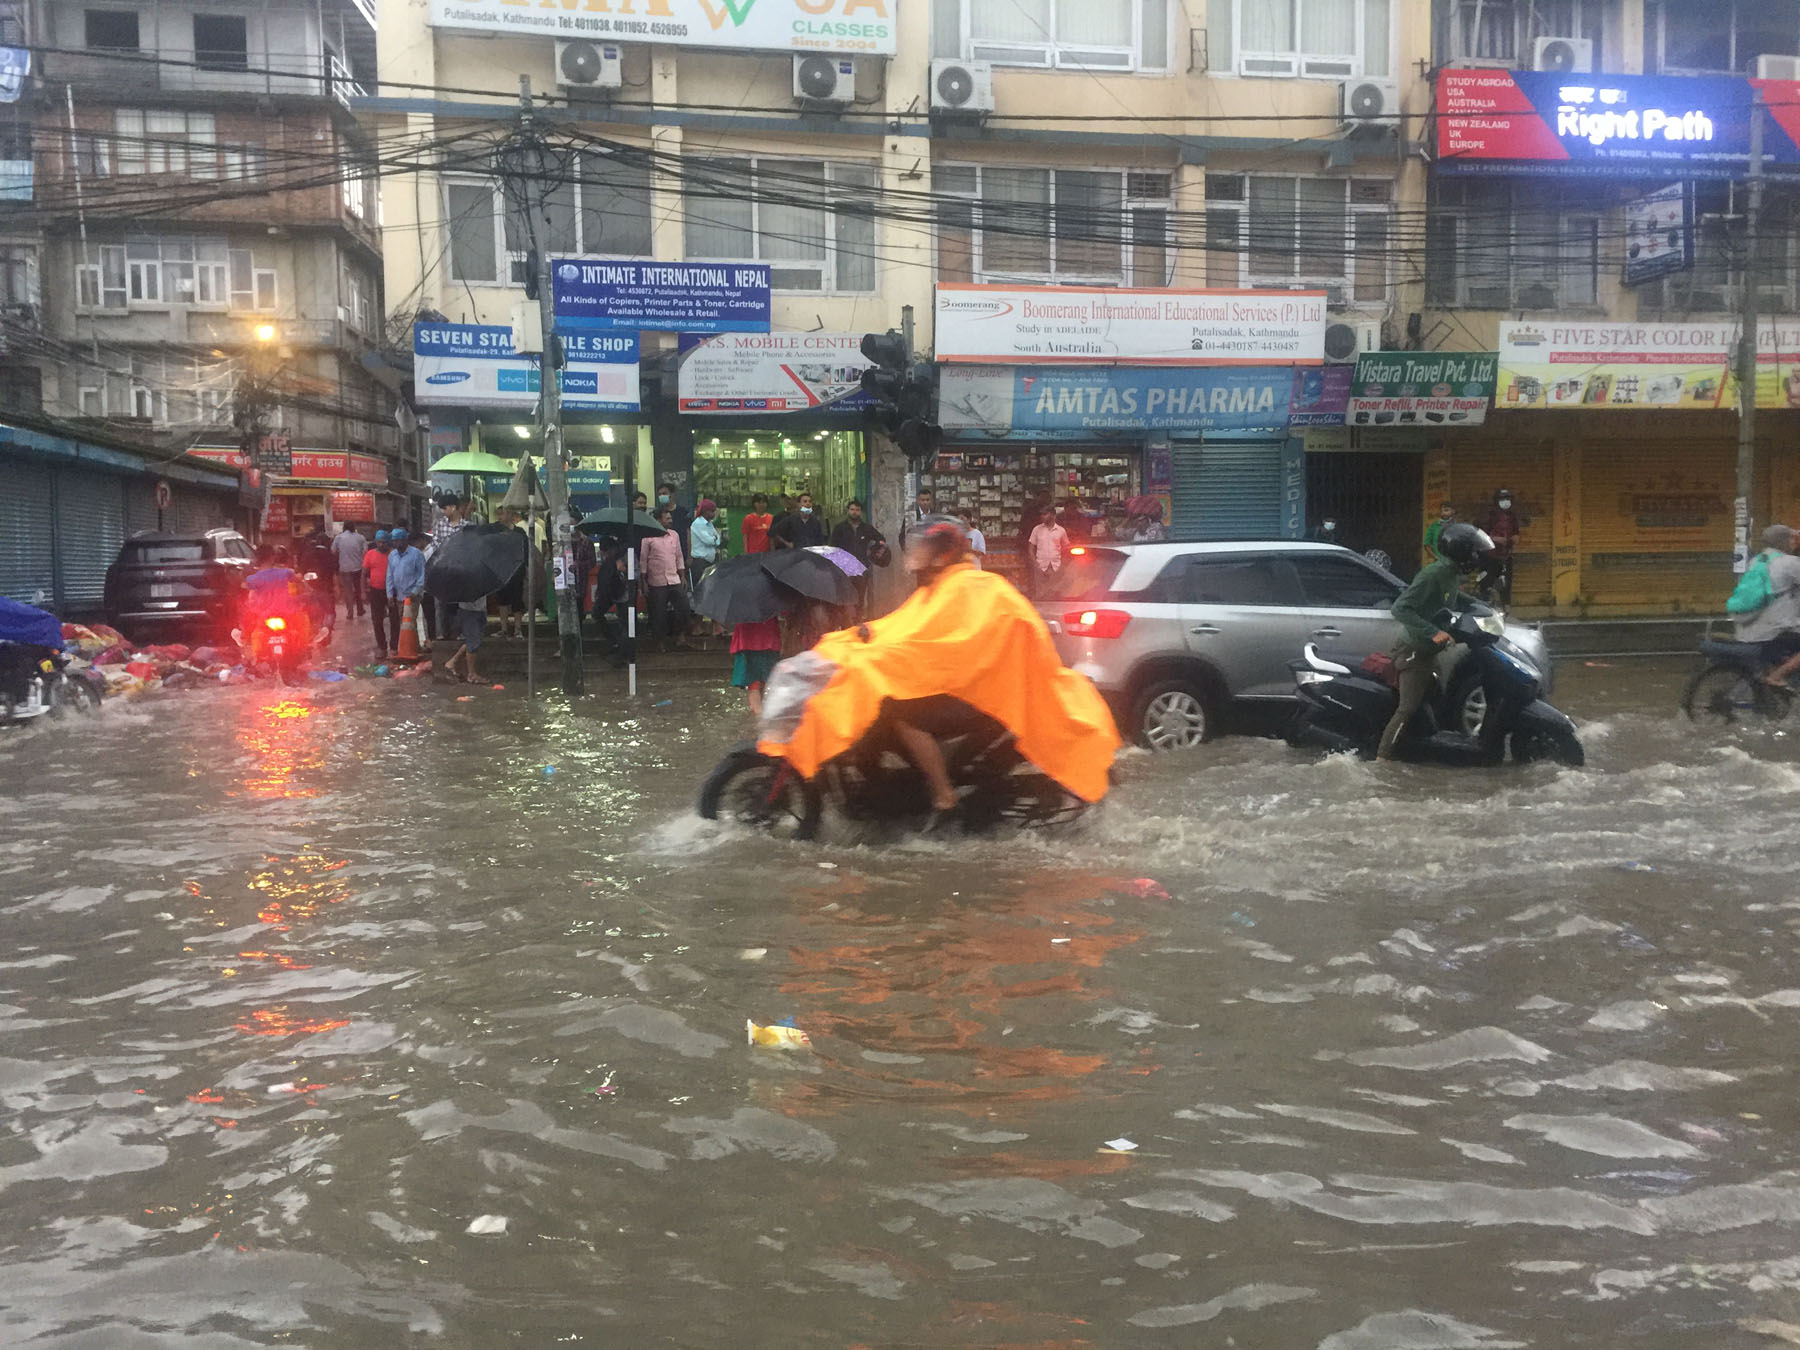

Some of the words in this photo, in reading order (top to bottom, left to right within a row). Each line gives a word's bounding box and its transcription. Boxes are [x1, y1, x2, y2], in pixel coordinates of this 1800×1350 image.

[503, 12, 556, 27] Kathmandu
[558, 16, 573, 29] Tel:
[792, 20, 888, 38] CLASSES
[792, 36, 830, 48] Since
[836, 38, 877, 49] 2004
[1446, 77, 1475, 87] STUDY
[1477, 79, 1515, 87] ABROAD
[1446, 88, 1465, 96] USA
[1448, 98, 1496, 107] AUSTRALIA
[1448, 119, 1468, 128] NEW
[1470, 120, 1510, 129] ZEALAND
[1557, 105, 1639, 145] Right
[1643, 108, 1713, 141] Path
[1449, 130, 1462, 138] UK
[1449, 140, 1485, 149] EUROPE
[582, 265, 637, 285] INTIMATE
[641, 267, 729, 287] INTERNATIONAL
[735, 269, 769, 288] NEPAL
[561, 296, 572, 304] All
[574, 296, 597, 304] Kinds
[644, 298, 671, 306] Printer
[673, 299, 693, 307] Parts
[704, 300, 727, 308] Toner,
[729, 300, 765, 309] Cartridge
[607, 307, 644, 316] Available
[645, 308, 686, 317] Wholesale
[688, 309, 694, 317] &
[1023, 299, 1088, 324] Boomerang
[1091, 300, 1161, 320] International
[1165, 301, 1229, 322] Educational
[1232, 302, 1278, 322] Services
[1302, 303, 1321, 322] Ltd
[1016, 323, 1042, 336] Study
[1192, 327, 1245, 338] Putalisadak,
[1248, 327, 1300, 338] Kathmandu
[420, 329, 473, 346] SEVEN
[592, 337, 634, 352] SHOP
[734, 337, 800, 349] MOBILE
[1552, 328, 1595, 345] FIVE
[1600, 328, 1647, 346] STAR
[1652, 329, 1715, 346] COLOR
[1013, 343, 1041, 353] South
[1045, 341, 1102, 353] Australia
[1359, 359, 1401, 382] Vistara
[1405, 359, 1444, 383] Travel
[1444, 360, 1467, 382] Pvt.
[1471, 358, 1494, 382] Ltd.
[564, 378, 596, 387] NOKIA
[1035, 387, 1138, 415] AMTAS
[1146, 386, 1275, 414] PHARMA
[1353, 399, 1381, 410] Toner
[1415, 398, 1450, 410] Printer
[1452, 399, 1486, 411] Repair
[1082, 416, 1148, 428] Putalisadak,
[1151, 417, 1215, 427] Kathmandu
